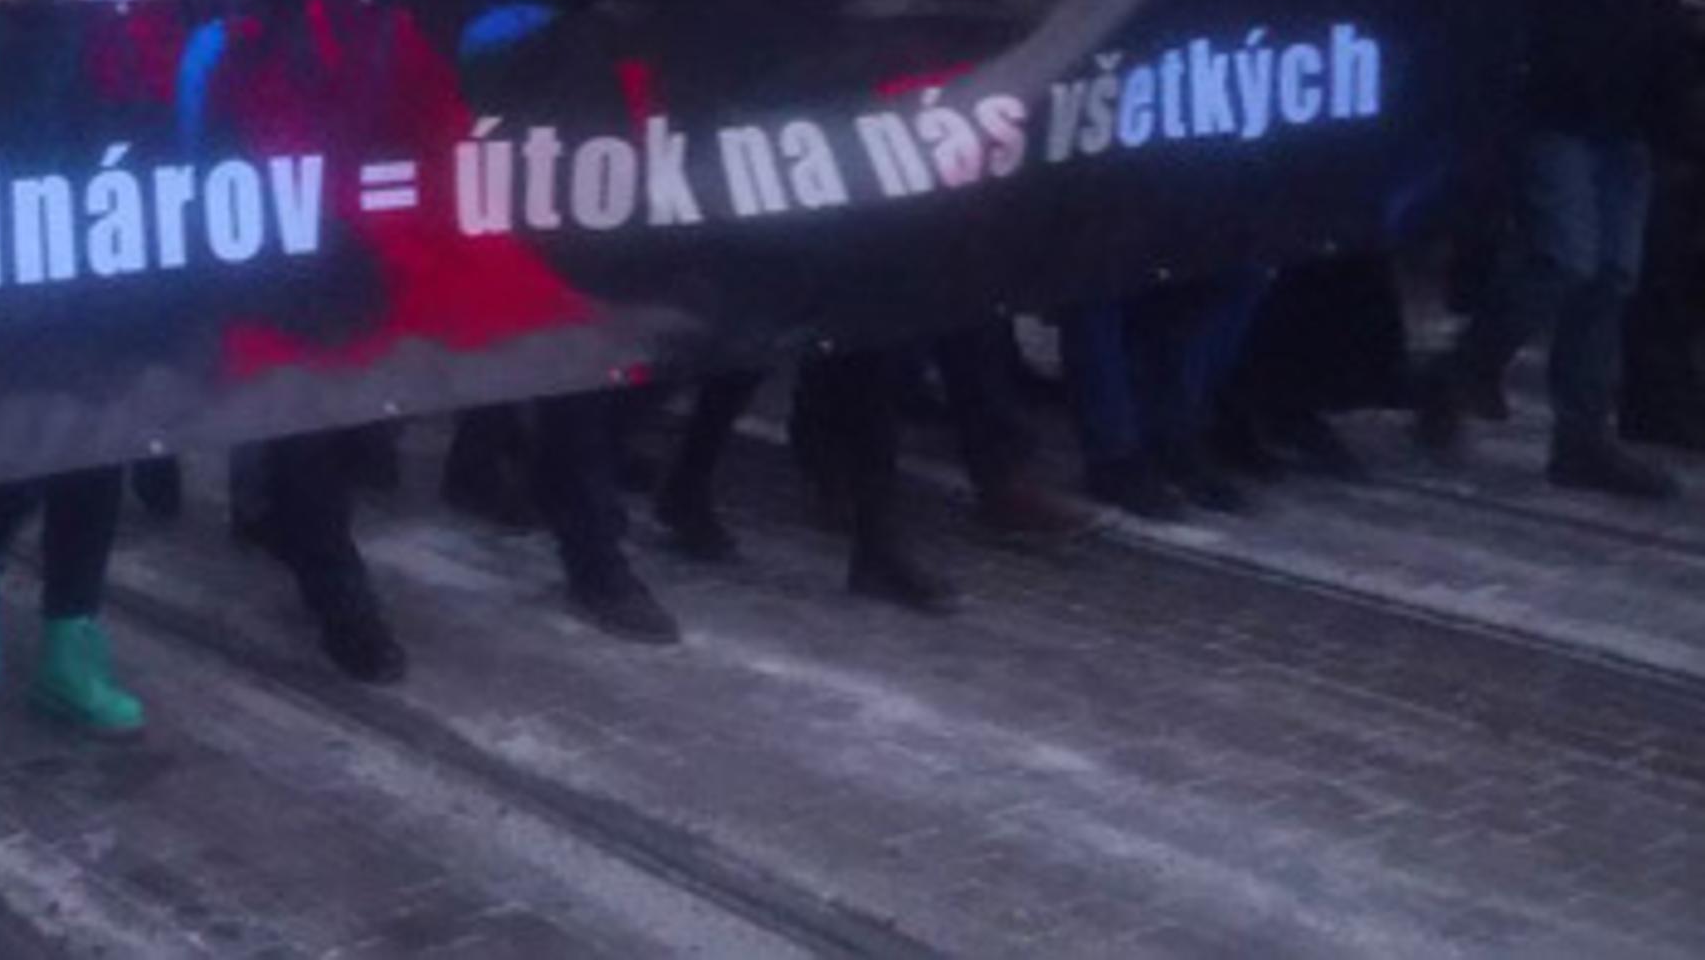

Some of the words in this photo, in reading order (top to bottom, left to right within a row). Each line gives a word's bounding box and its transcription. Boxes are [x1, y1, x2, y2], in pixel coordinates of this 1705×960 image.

[360, 159, 417, 211] =
[455, 115, 704, 236] útok
[717, 120, 849, 216] na
[854, 87, 1026, 197] nás
[1046, 23, 1381, 162] všetkých
